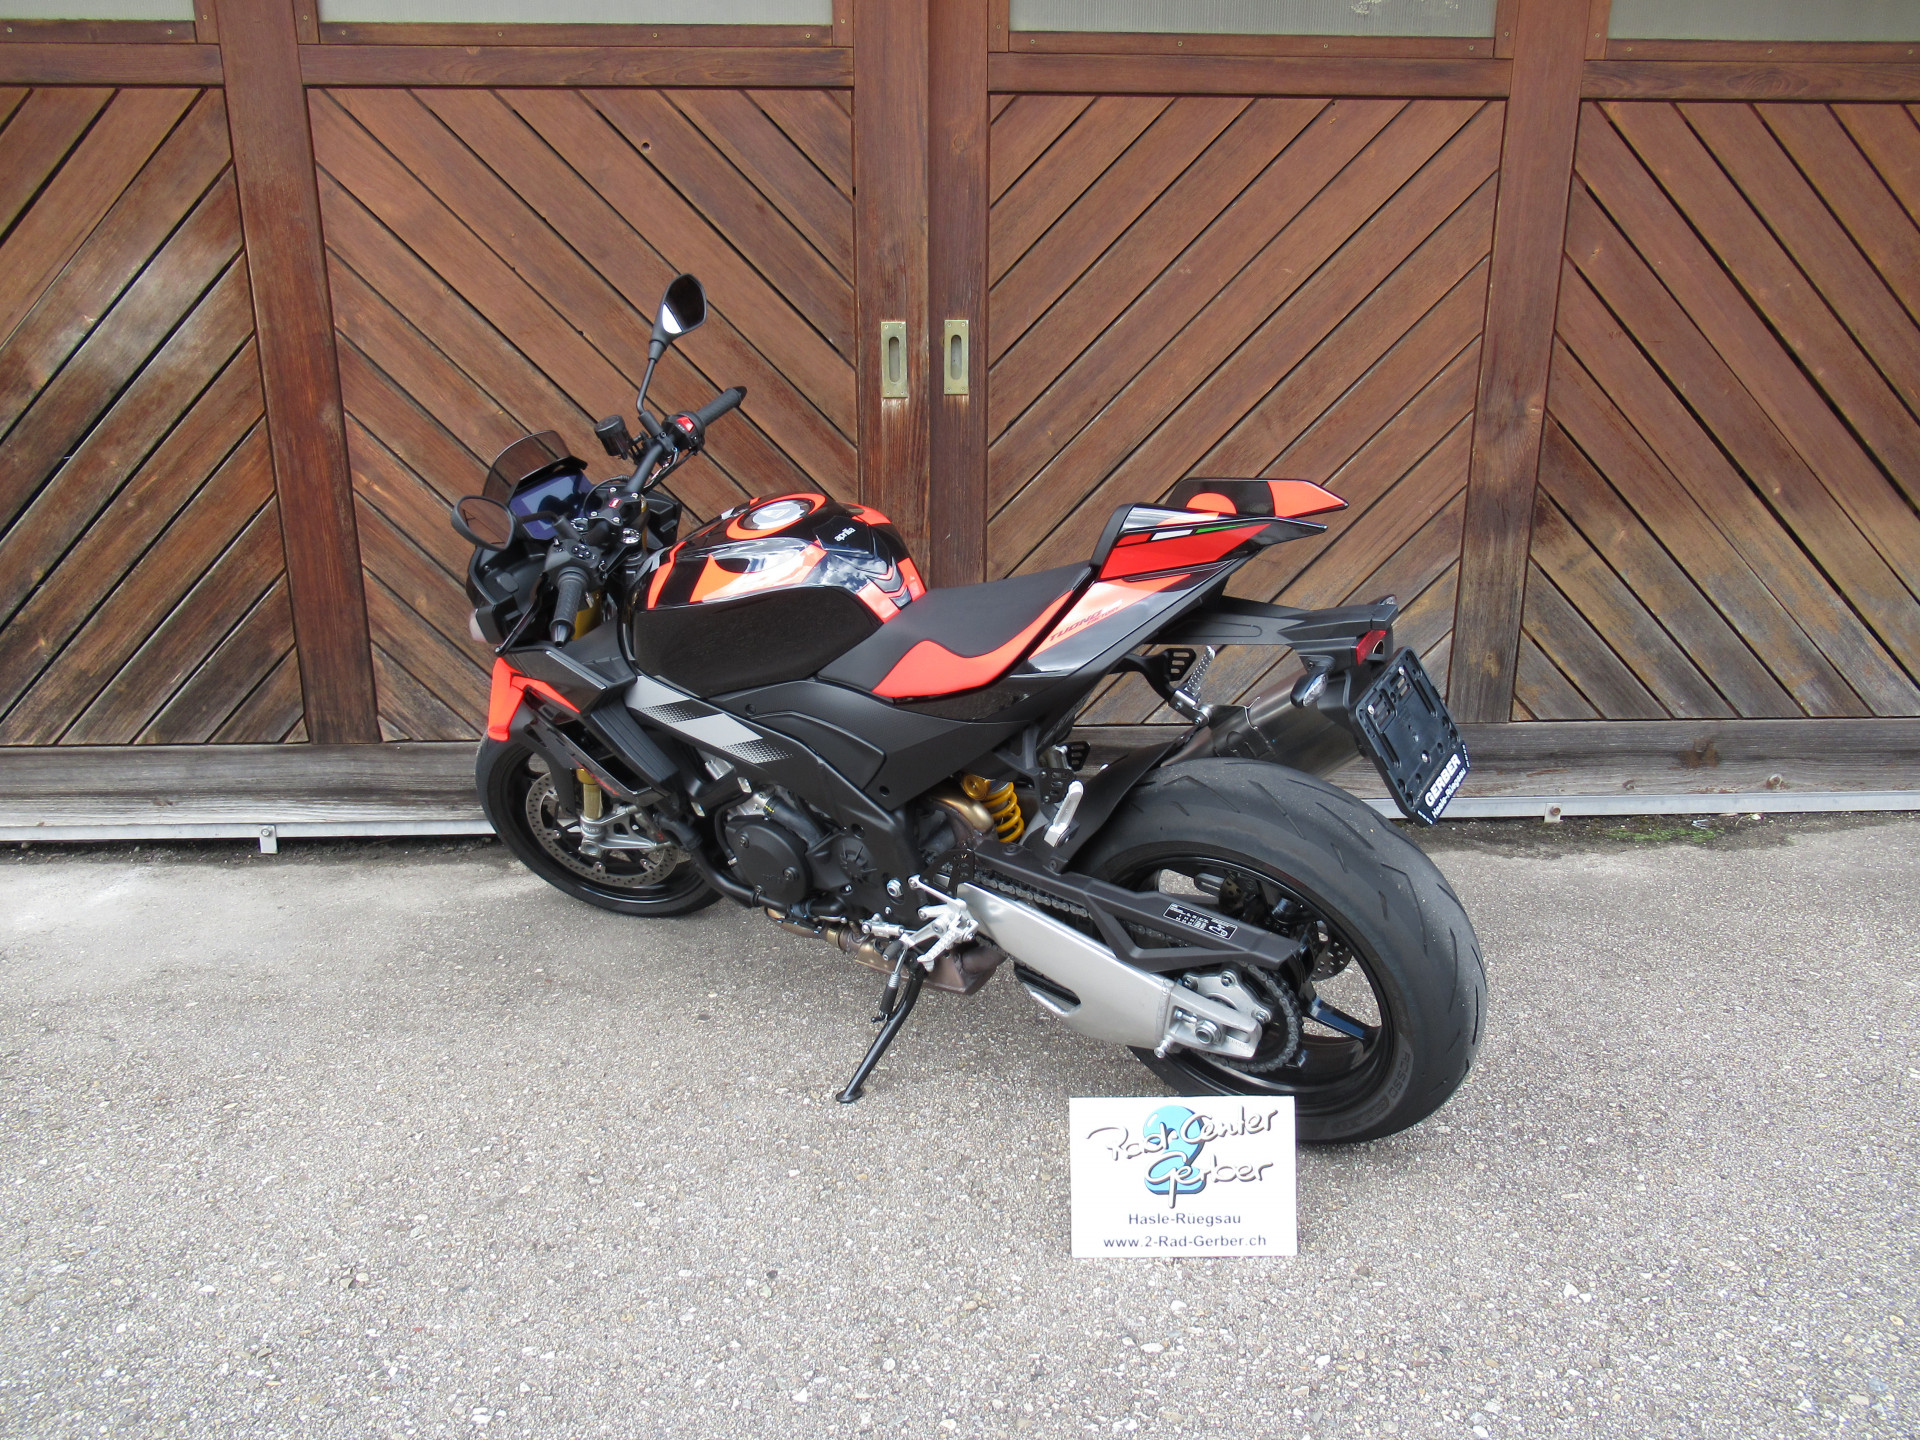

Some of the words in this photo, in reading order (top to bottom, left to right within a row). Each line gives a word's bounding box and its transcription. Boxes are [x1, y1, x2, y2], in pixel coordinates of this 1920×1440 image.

[834, 527, 856, 542] aprilia
[1049, 609, 1103, 642] TUONO
[1424, 753, 1461, 808] GERBER
[1180, 1105, 1279, 1145] Center
[1144, 1151, 1274, 1209] Gerber
[1128, 1212, 1242, 1228] Hasle-Rüegsau
[1103, 1234, 1267, 1248] www.2-Rad-Gerber.ch
